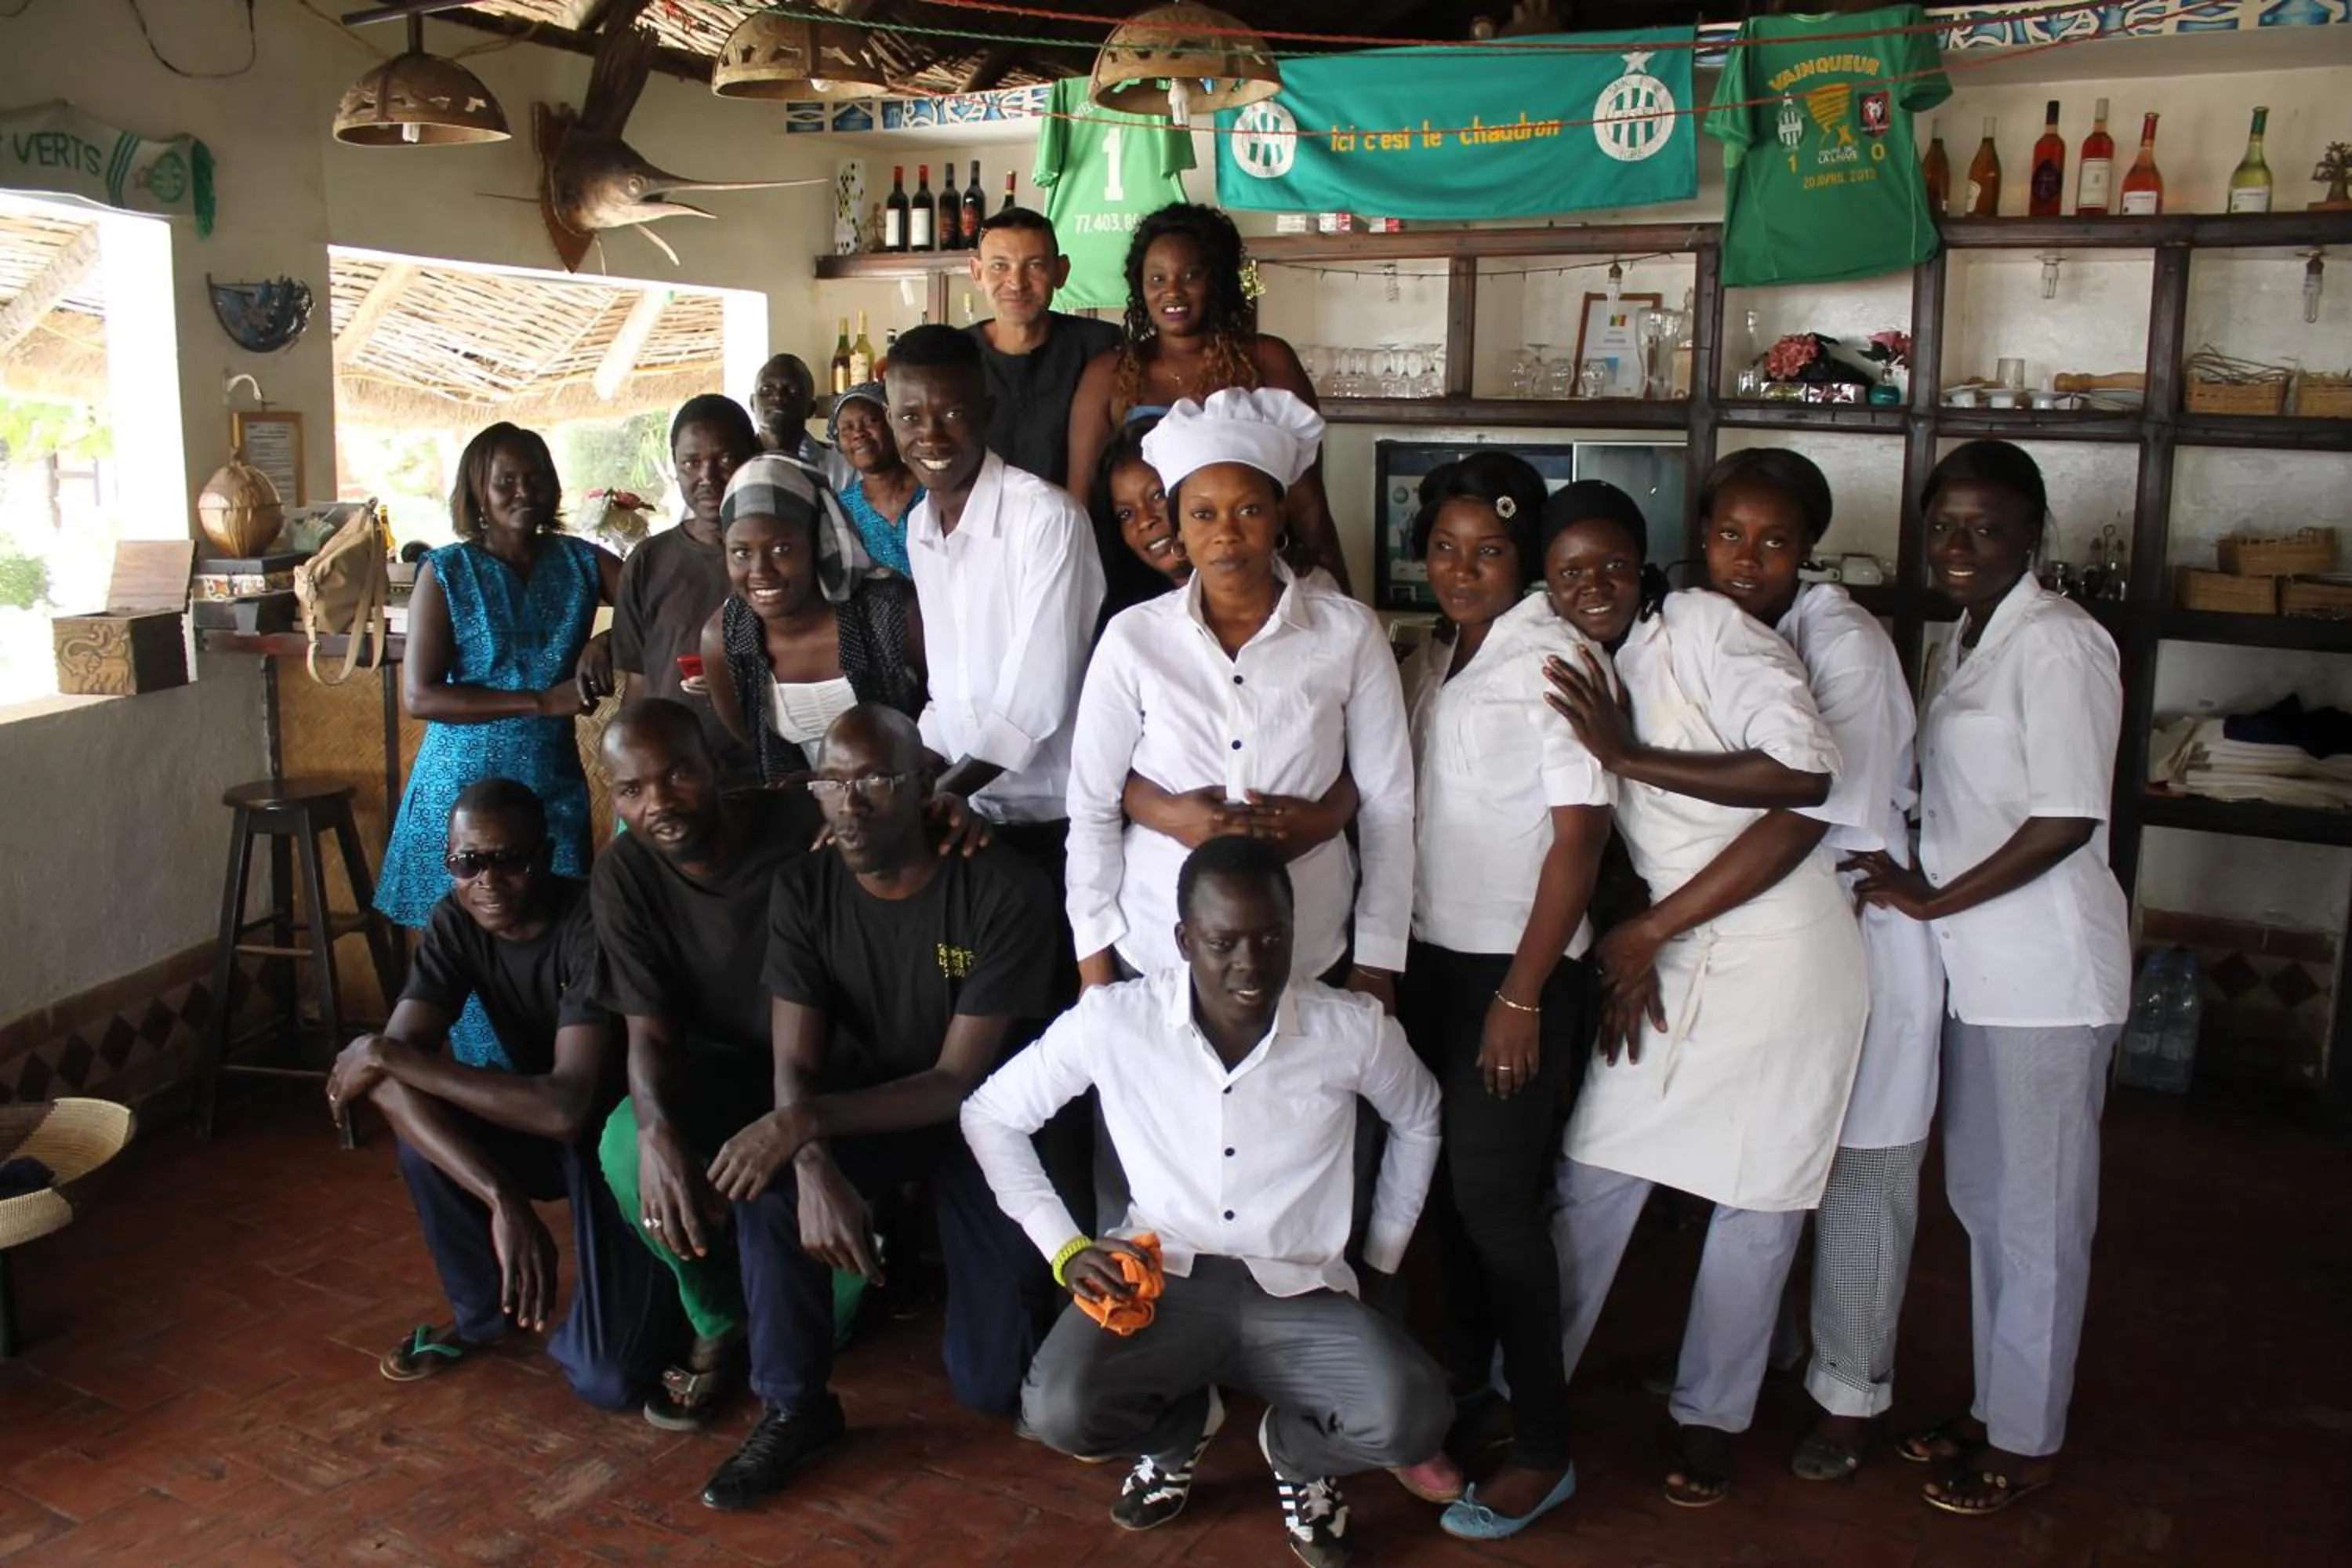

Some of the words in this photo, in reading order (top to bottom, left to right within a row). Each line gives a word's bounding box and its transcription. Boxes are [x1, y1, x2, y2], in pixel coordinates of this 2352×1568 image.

[1363, 126, 1410, 151] cest
[1421, 119, 1443, 148] le
[1459, 112, 1562, 145] chaudron
[13, 132, 102, 177] VERTS
[1102, 127, 1124, 201] 1
